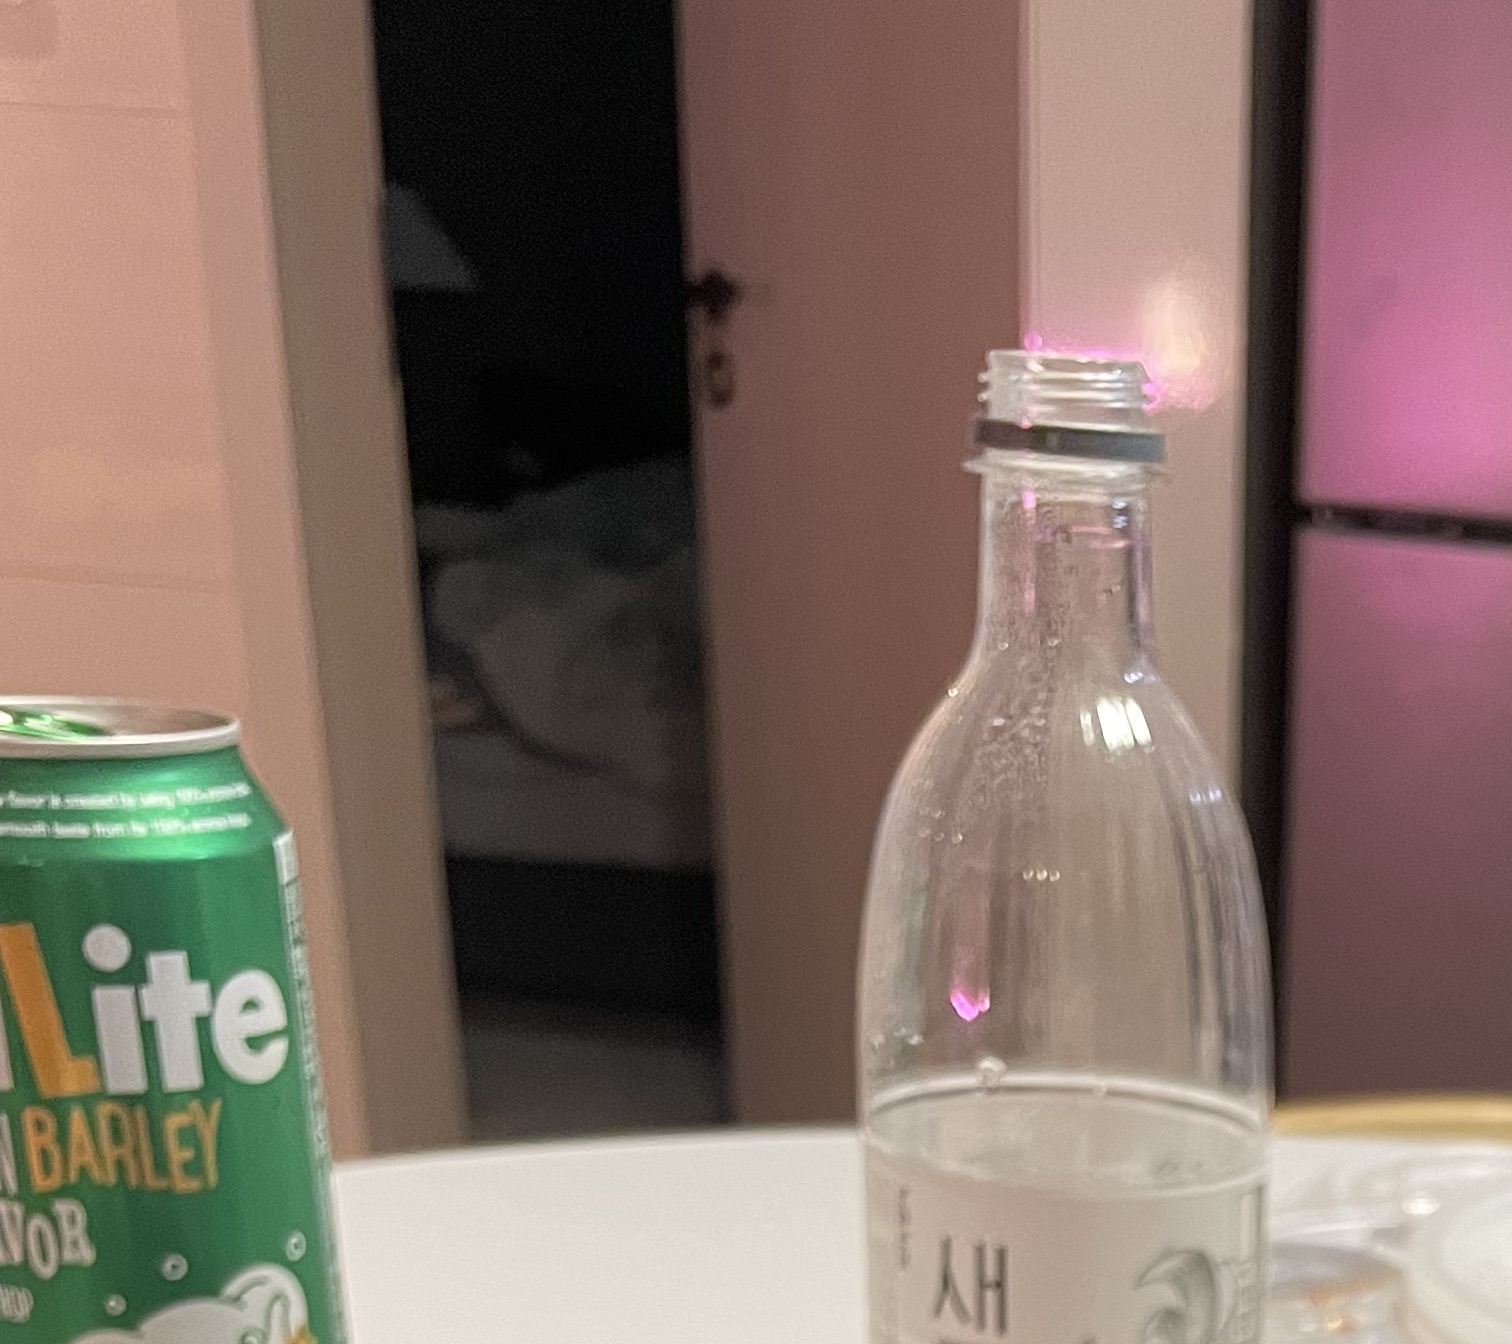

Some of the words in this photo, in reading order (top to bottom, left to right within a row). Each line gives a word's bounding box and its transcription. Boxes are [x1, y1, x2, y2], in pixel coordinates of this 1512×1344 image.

[0, 922, 290, 1098] Lite
[20, 1098, 223, 1194] BARLEY
[0, 1197, 98, 1280] VOR
